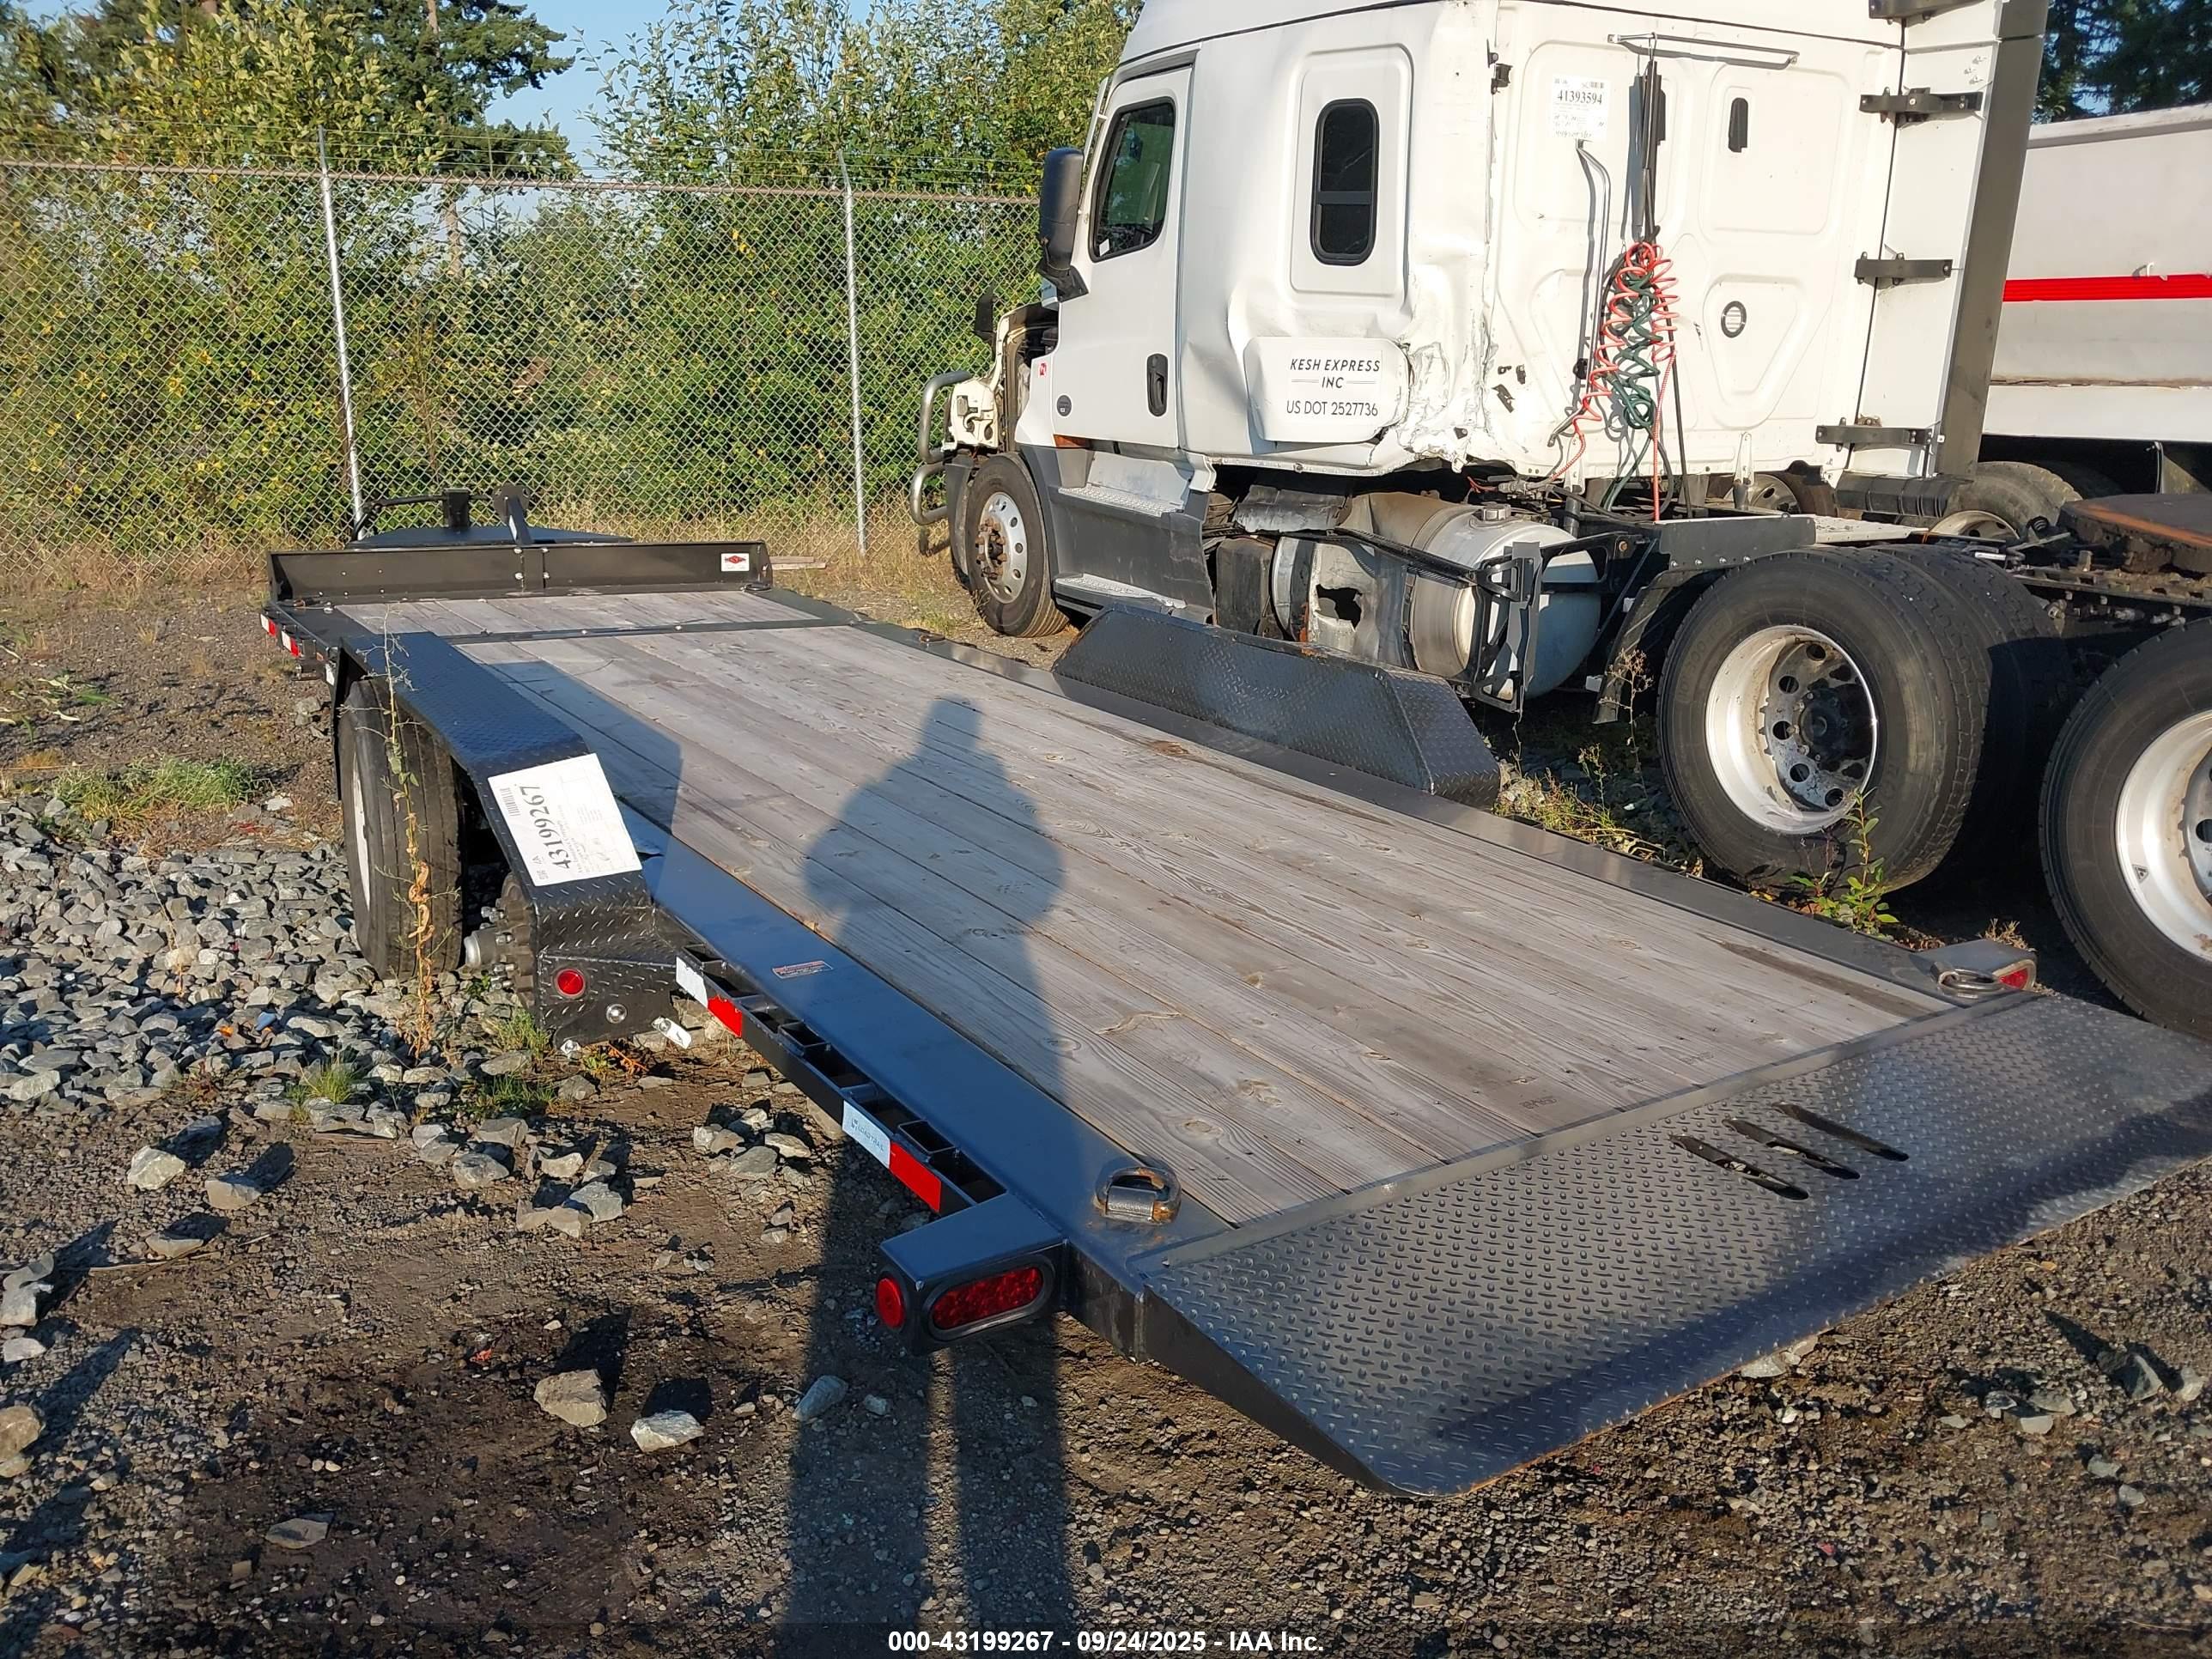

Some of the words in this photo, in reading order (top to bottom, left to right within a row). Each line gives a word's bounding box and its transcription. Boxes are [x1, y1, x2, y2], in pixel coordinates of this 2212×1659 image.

[1557, 89, 1603, 106] 41393594
[1290, 358, 1321, 371] KESH
[1324, 359, 1381, 372] EXPRESS
[1322, 377, 1344, 388] INC
[1286, 400, 1301, 414] US
[1304, 401, 1328, 415] DOT
[1331, 402, 1378, 416] 2527736
[518, 784, 571, 870] 43199267
